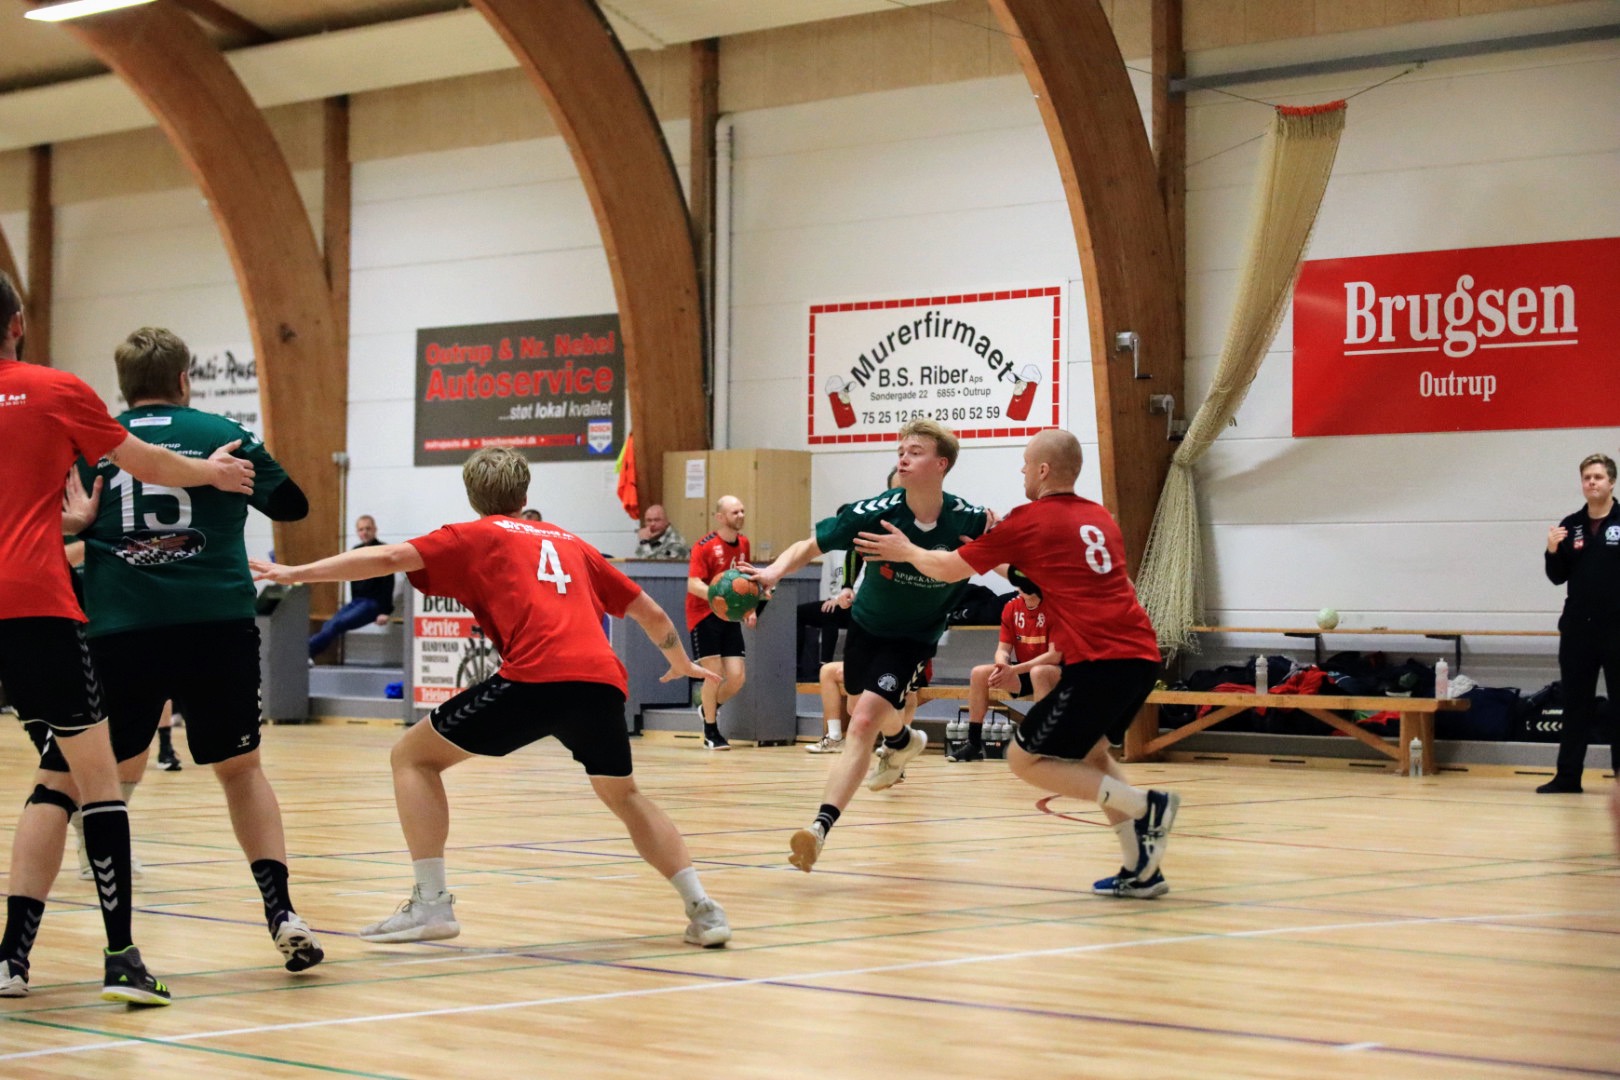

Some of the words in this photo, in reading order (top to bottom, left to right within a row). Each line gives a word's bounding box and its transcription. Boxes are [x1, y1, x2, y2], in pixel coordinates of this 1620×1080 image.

[1343, 274, 1578, 358] Brugsen
[425, 342, 493, 367] Outrup
[498, 337, 514, 360] &
[519, 336, 548, 358] Nr.
[554, 331, 615, 357] Nebel
[851, 310, 1014, 387] Murerfirmaet
[425, 361, 614, 401] Autoservice
[879, 367, 914, 387] B.S.
[920, 365, 968, 385] Riber
[969, 375, 983, 384] Aps
[918, 389, 929, 398] 22
[936, 388, 956, 398] 6855
[962, 387, 991, 397] Outrup
[1419, 370, 1497, 402] Outrup
[535, 402, 567, 418] lokal
[568, 399, 613, 417] kvalitet
[862, 411, 875, 424] 75
[878, 411, 891, 424] 25
[896, 410, 908, 423] 12
[911, 409, 924, 420] 65
[935, 408, 949, 421] 23
[952, 407, 966, 420] 60
[969, 406, 983, 419] 52
[986, 406, 1000, 419] 59
[109, 468, 193, 533] 15
[1080, 524, 1112, 574] 8
[537, 539, 572, 594] 4
[421, 618, 460, 637] Service
[1014, 611, 1025, 629] 15
